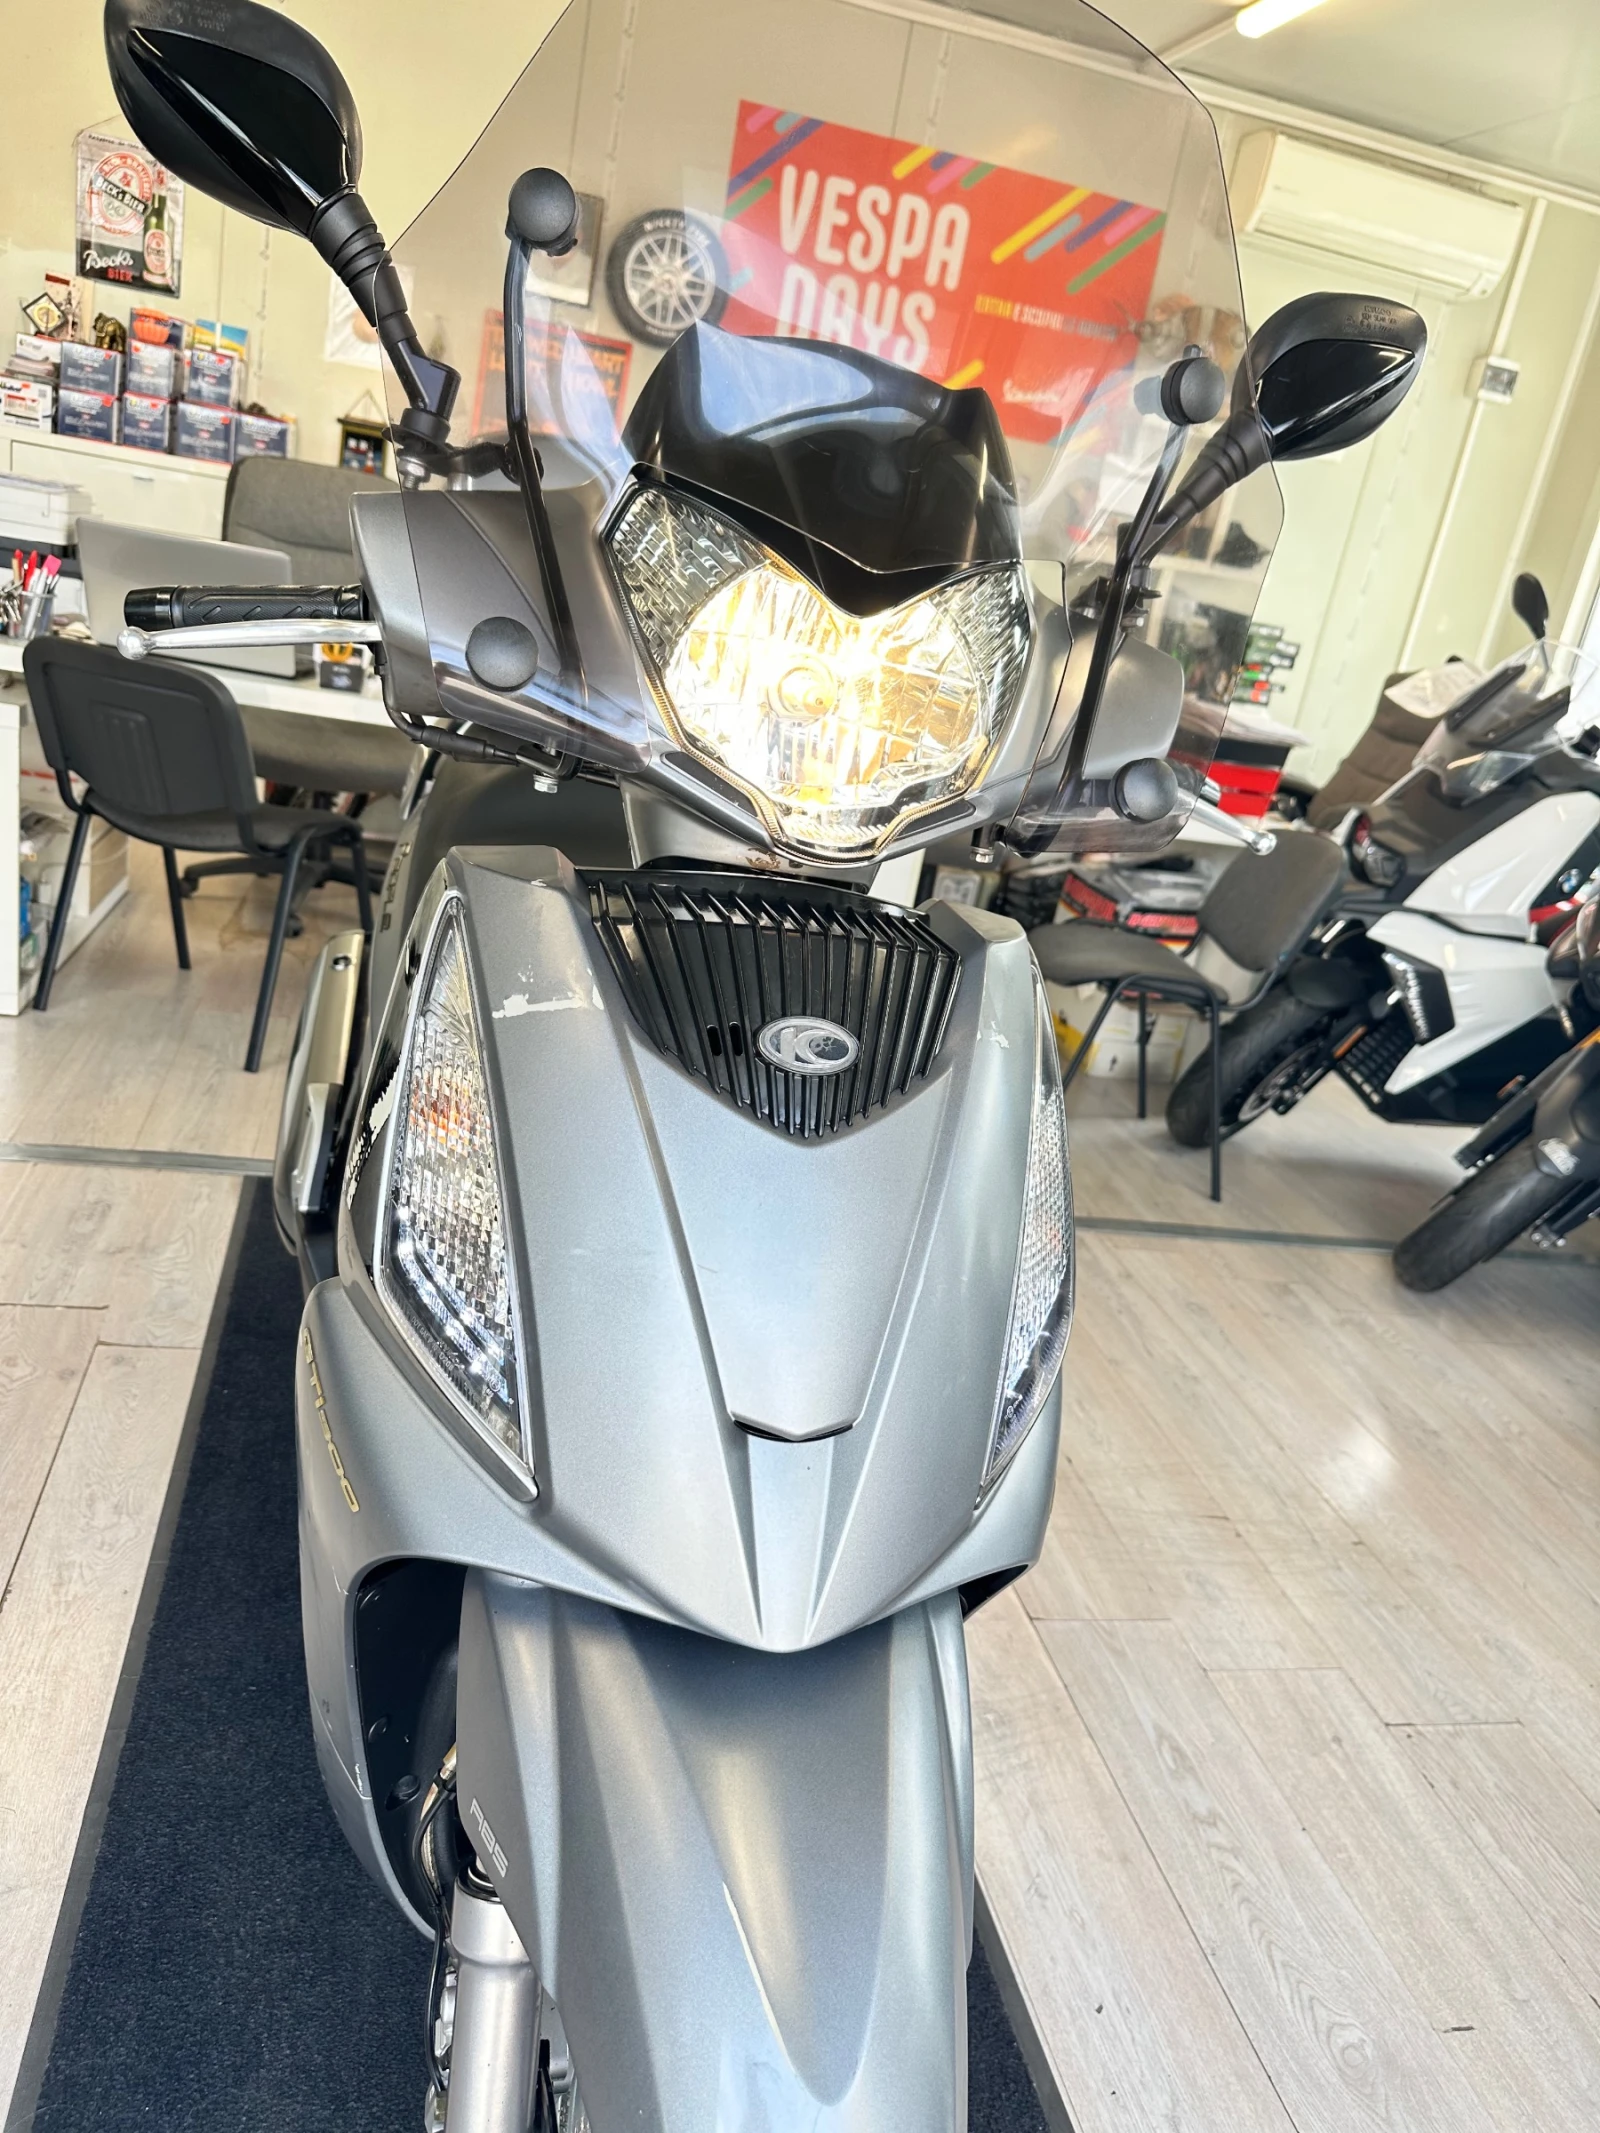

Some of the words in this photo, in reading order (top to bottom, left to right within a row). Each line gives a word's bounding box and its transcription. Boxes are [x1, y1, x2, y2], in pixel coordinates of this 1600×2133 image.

[779, 164, 971, 292] VESPA
[774, 263, 936, 374] DAYS
[470, 1798, 508, 1878] ABS
